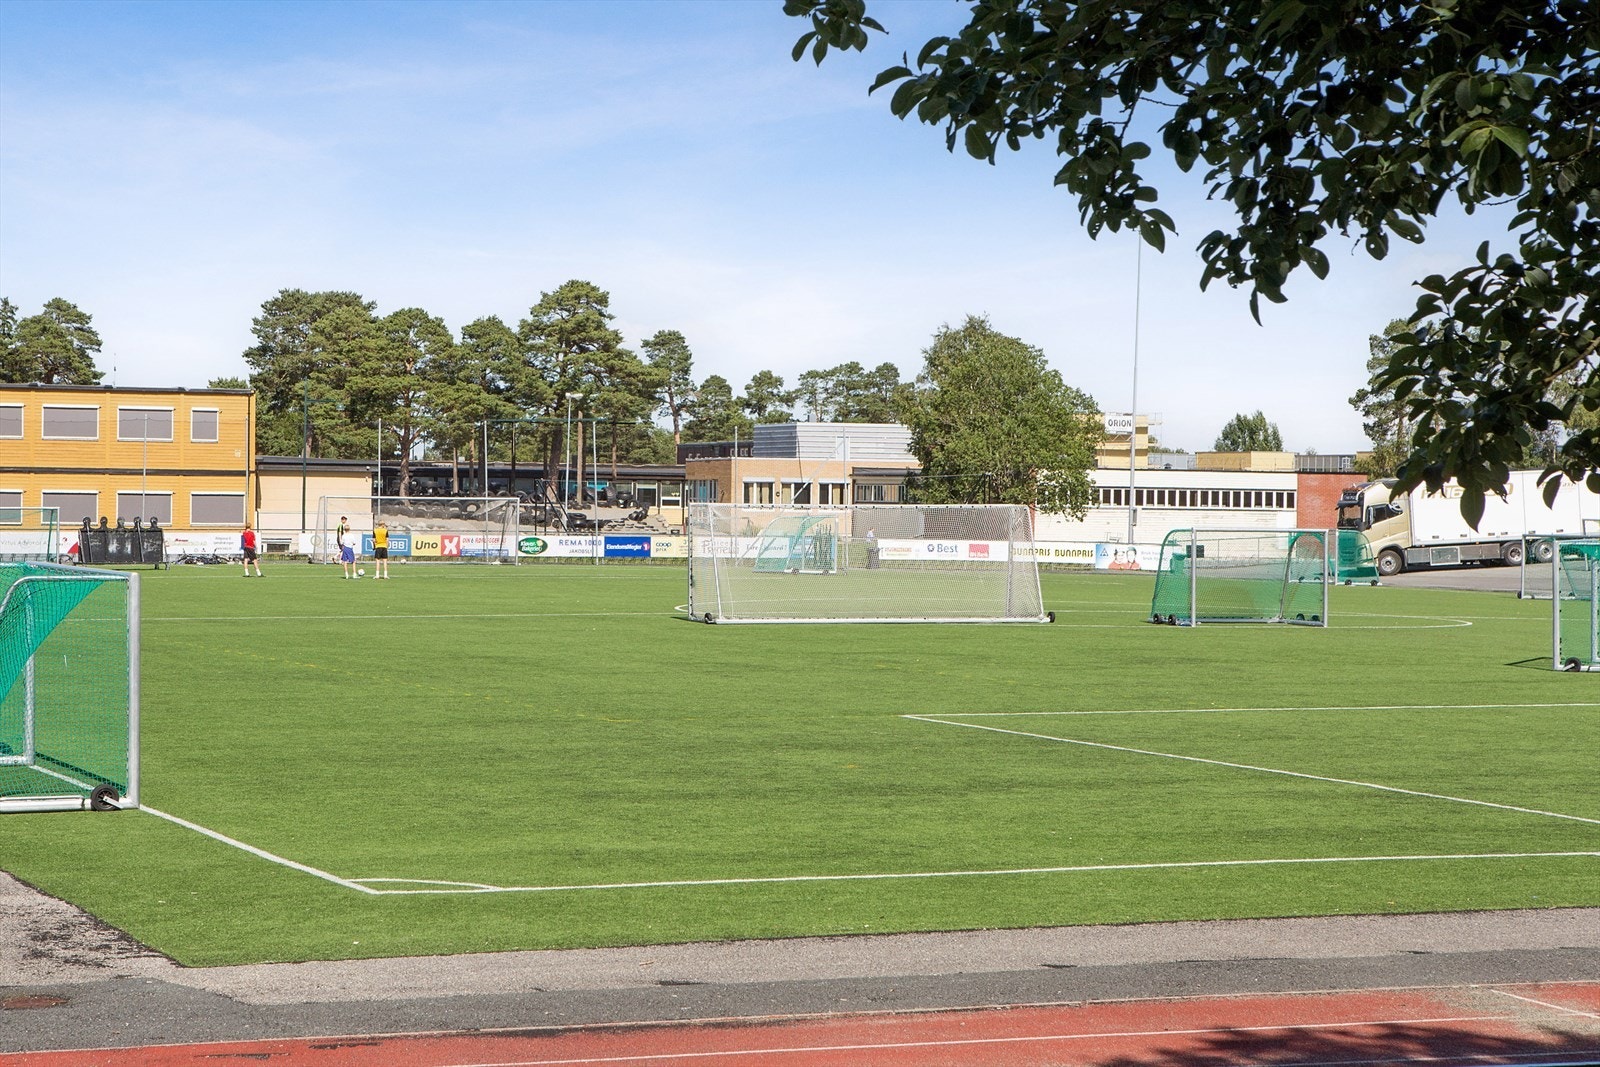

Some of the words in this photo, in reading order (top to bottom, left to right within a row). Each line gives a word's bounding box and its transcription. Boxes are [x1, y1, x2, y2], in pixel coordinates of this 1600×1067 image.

[1108, 419, 1132, 427] ORION
[415, 540, 438, 550] Uno
[443, 536, 459, 555] X
[936, 543, 958, 553] Best
[1055, 549, 1094, 558] BUNNPRIS
